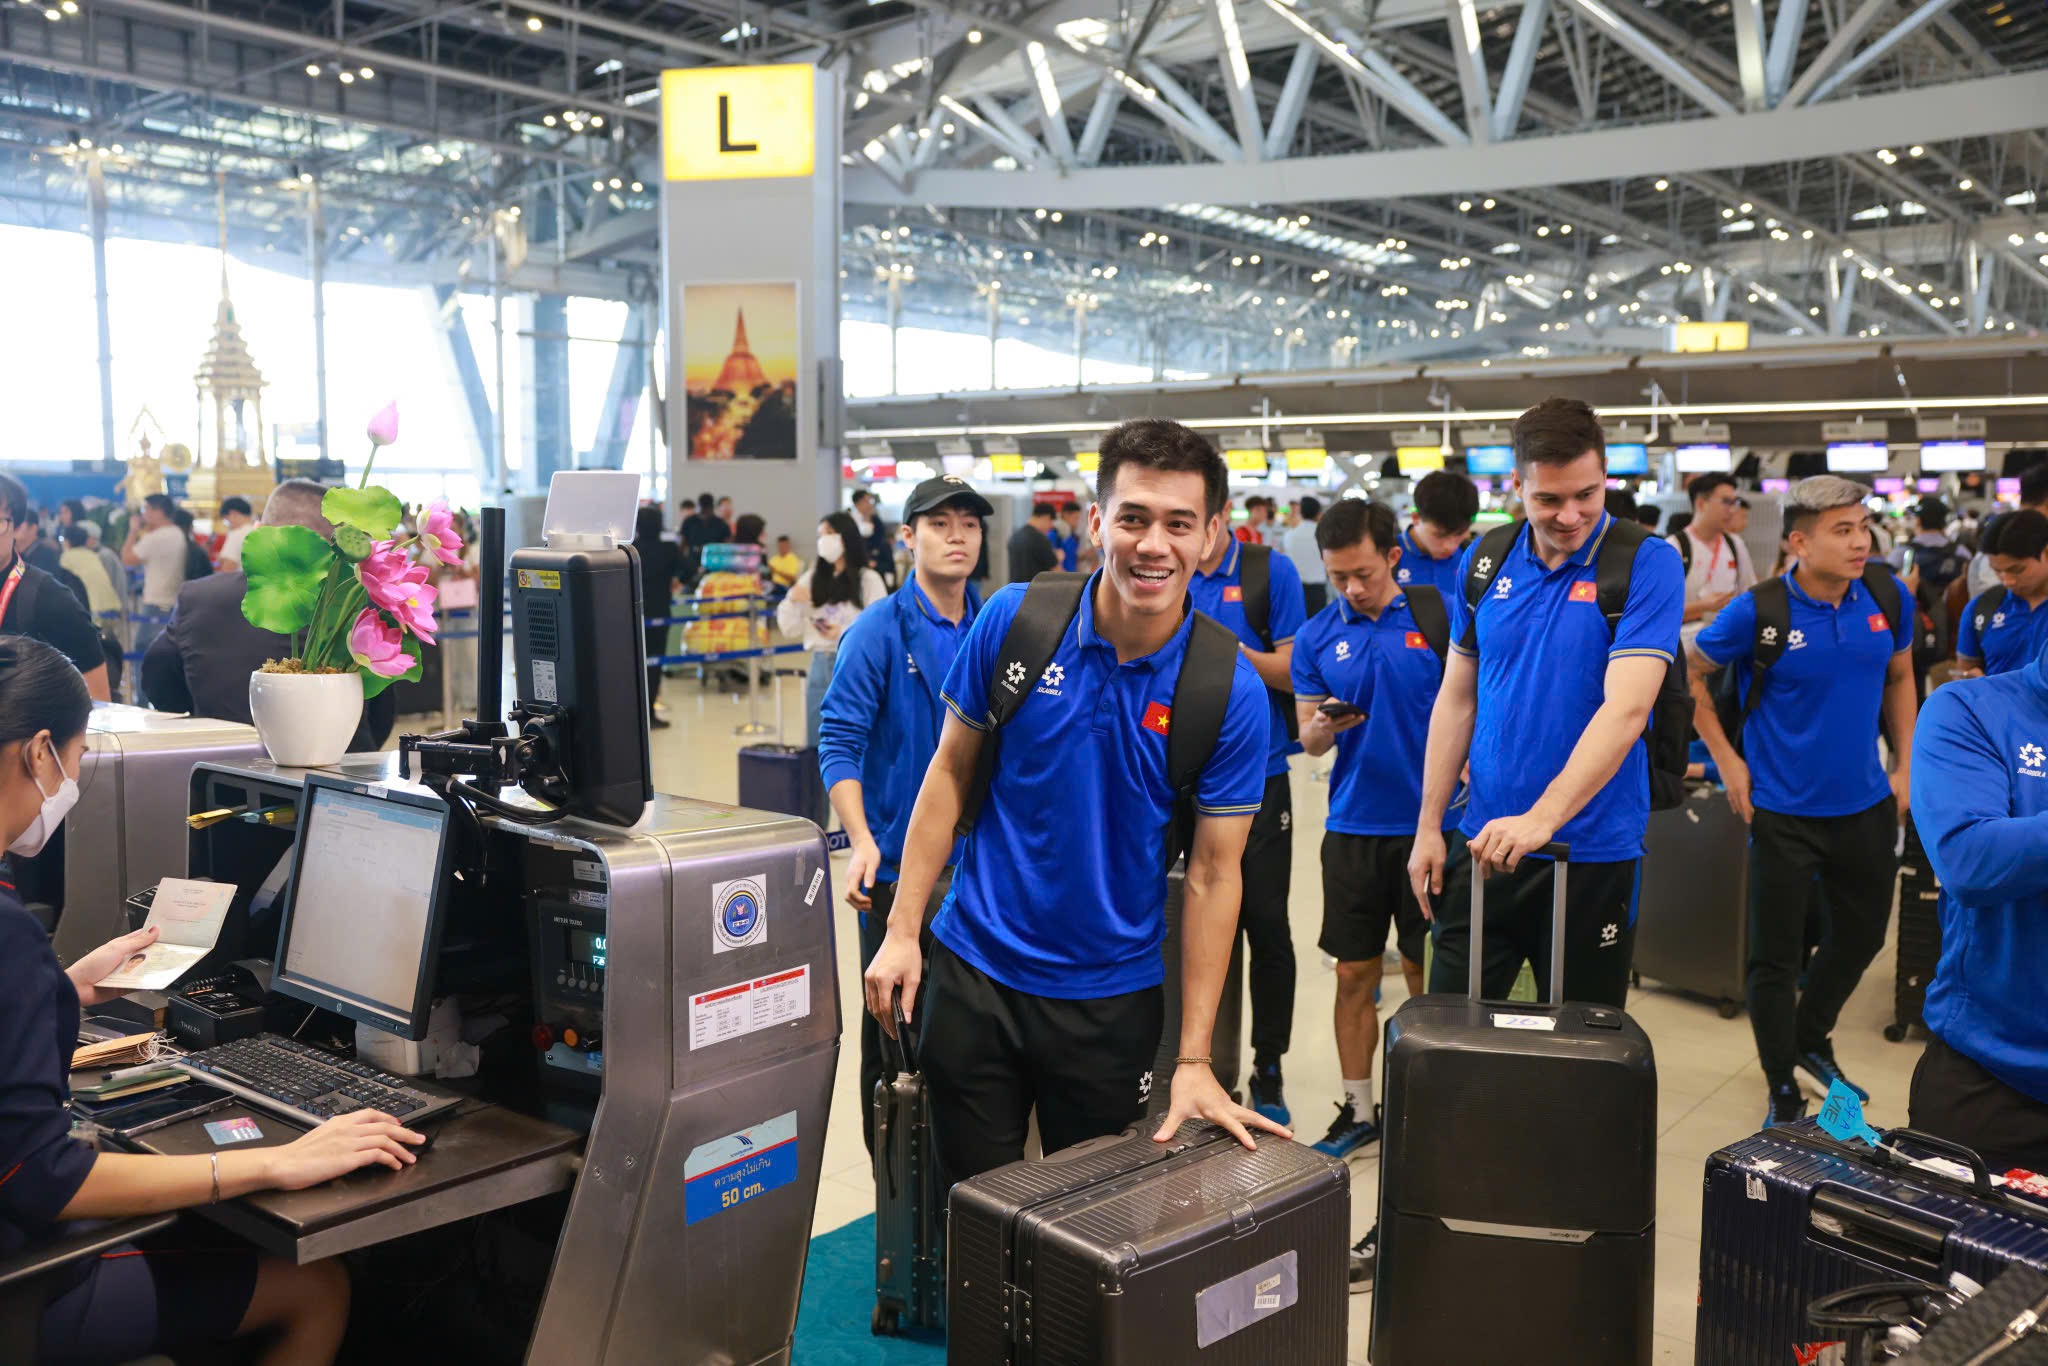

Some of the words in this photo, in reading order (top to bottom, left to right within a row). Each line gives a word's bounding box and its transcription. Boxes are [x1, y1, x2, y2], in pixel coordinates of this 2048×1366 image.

[719, 95, 757, 152] L
[828, 833, 848, 849] OT
[181, 1021, 201, 1035] THALES
[1824, 1095, 1846, 1125] VIE
[721, 1187, 740, 1208] 50
[743, 1182, 765, 1199] cm.
